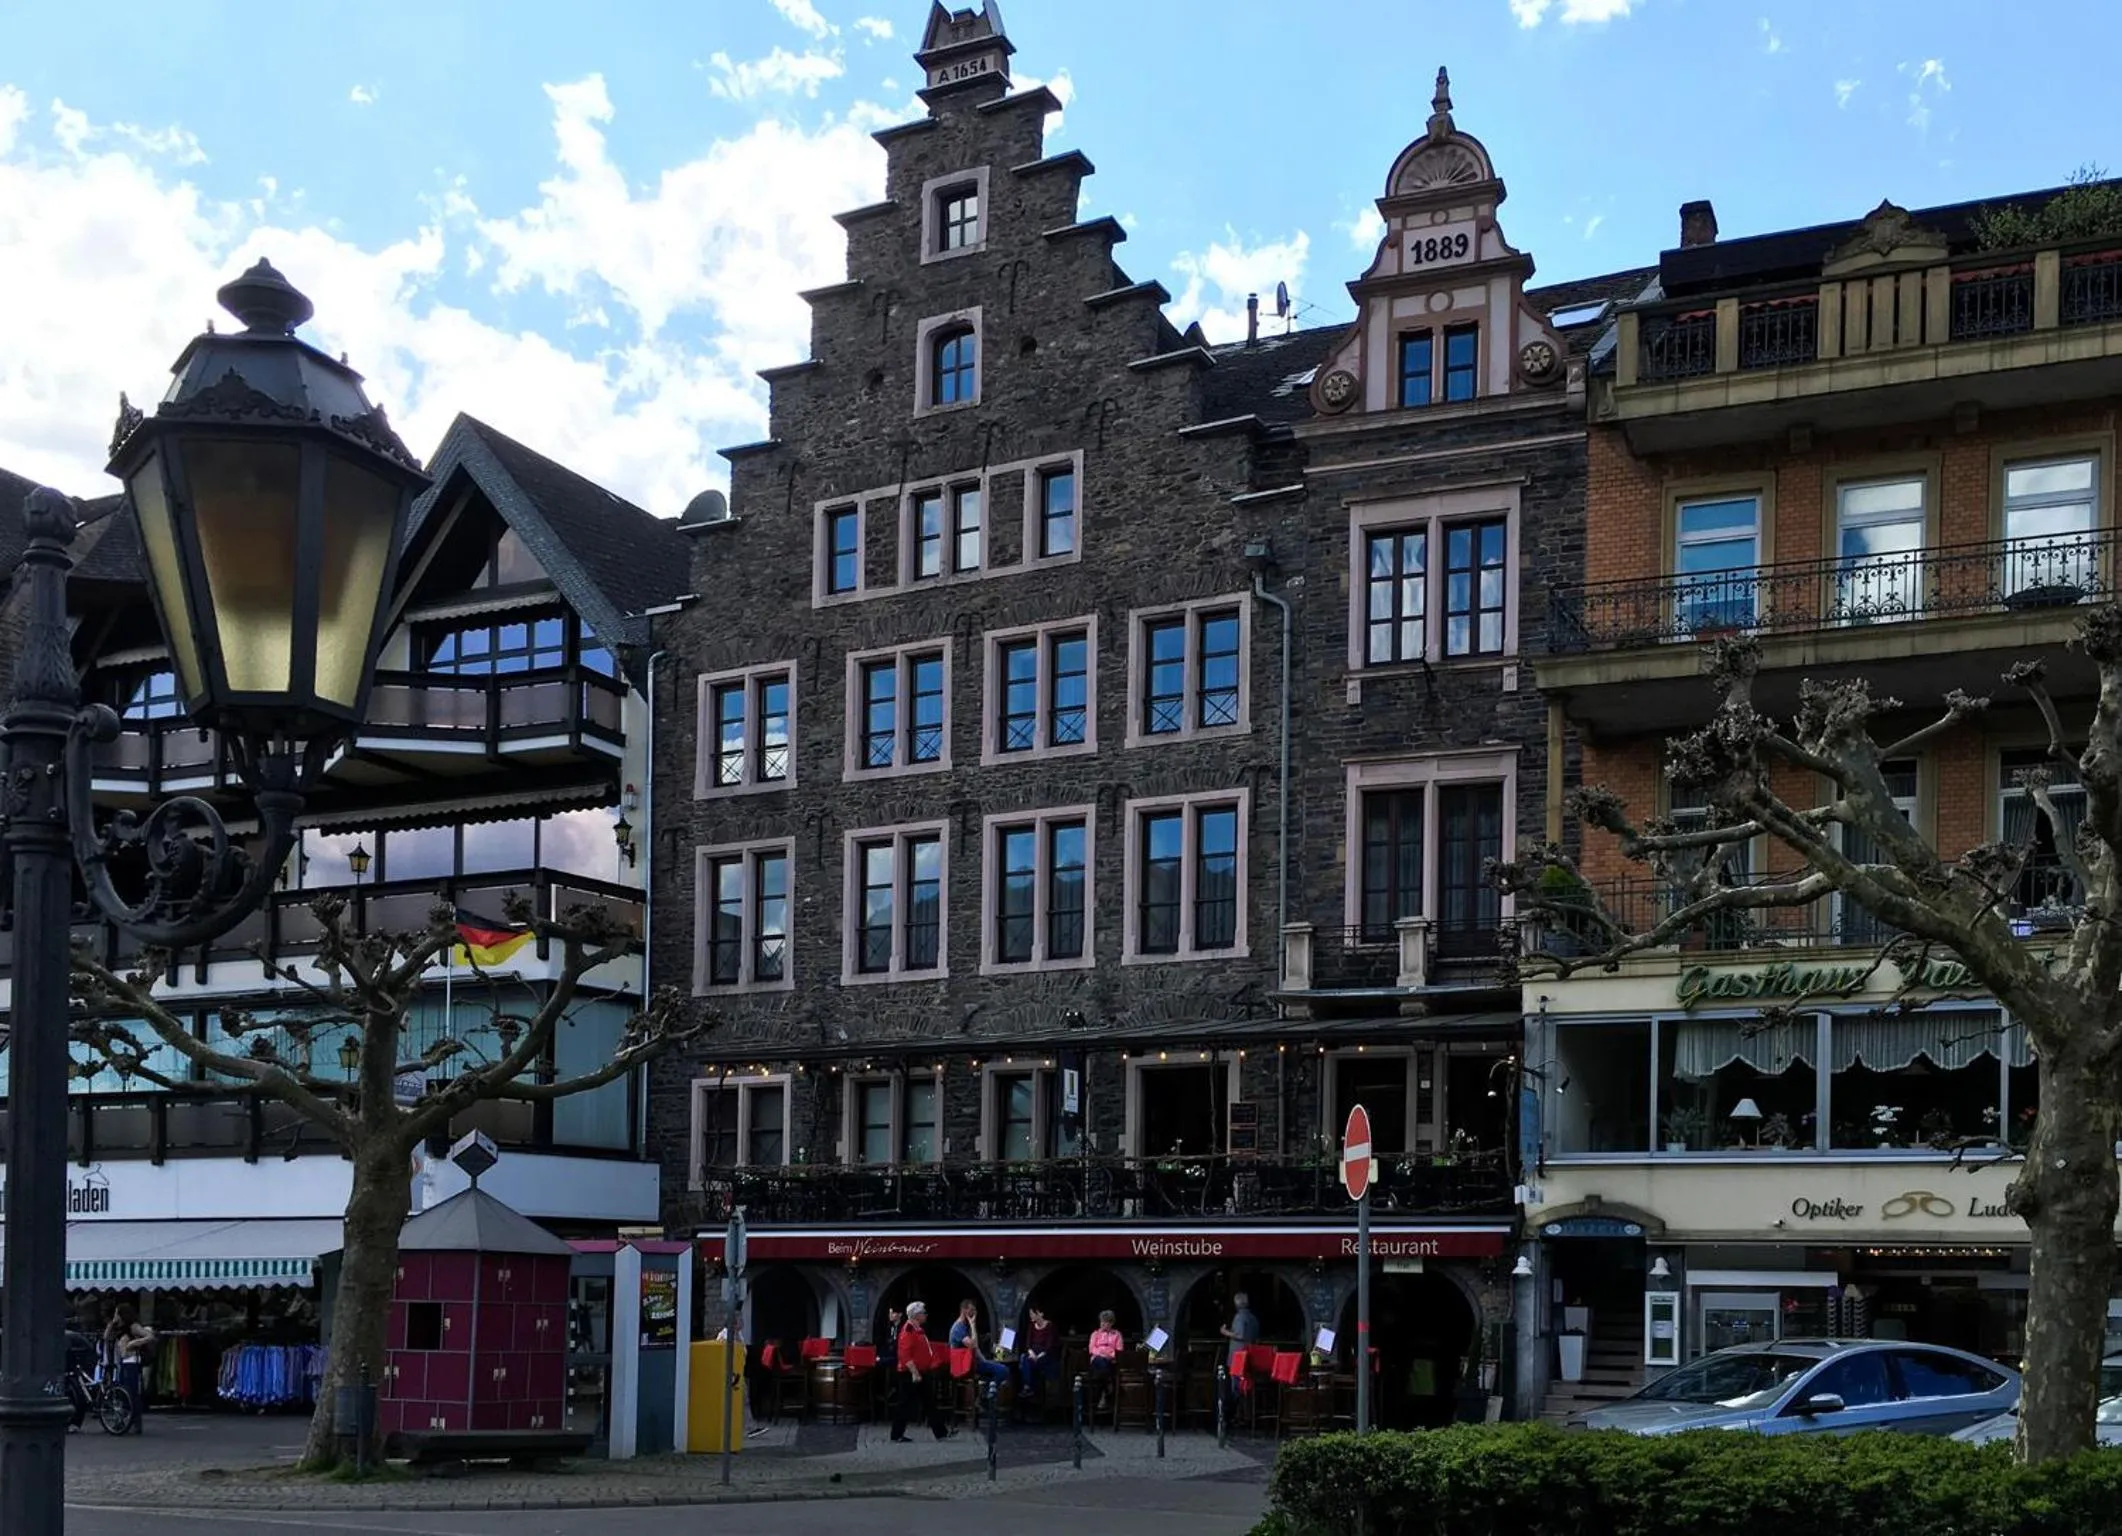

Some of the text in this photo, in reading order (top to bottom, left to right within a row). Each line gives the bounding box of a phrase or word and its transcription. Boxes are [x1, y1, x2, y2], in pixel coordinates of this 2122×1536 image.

[937, 58, 987, 84] A 1654
[1411, 233, 1469, 265] 1889
[1792, 1197, 1863, 1221] Optiker
[828, 1241, 852, 1255] Beim
[1131, 1238, 1222, 1256] Weinstube
[1341, 1238, 1438, 1256] Retaurant
